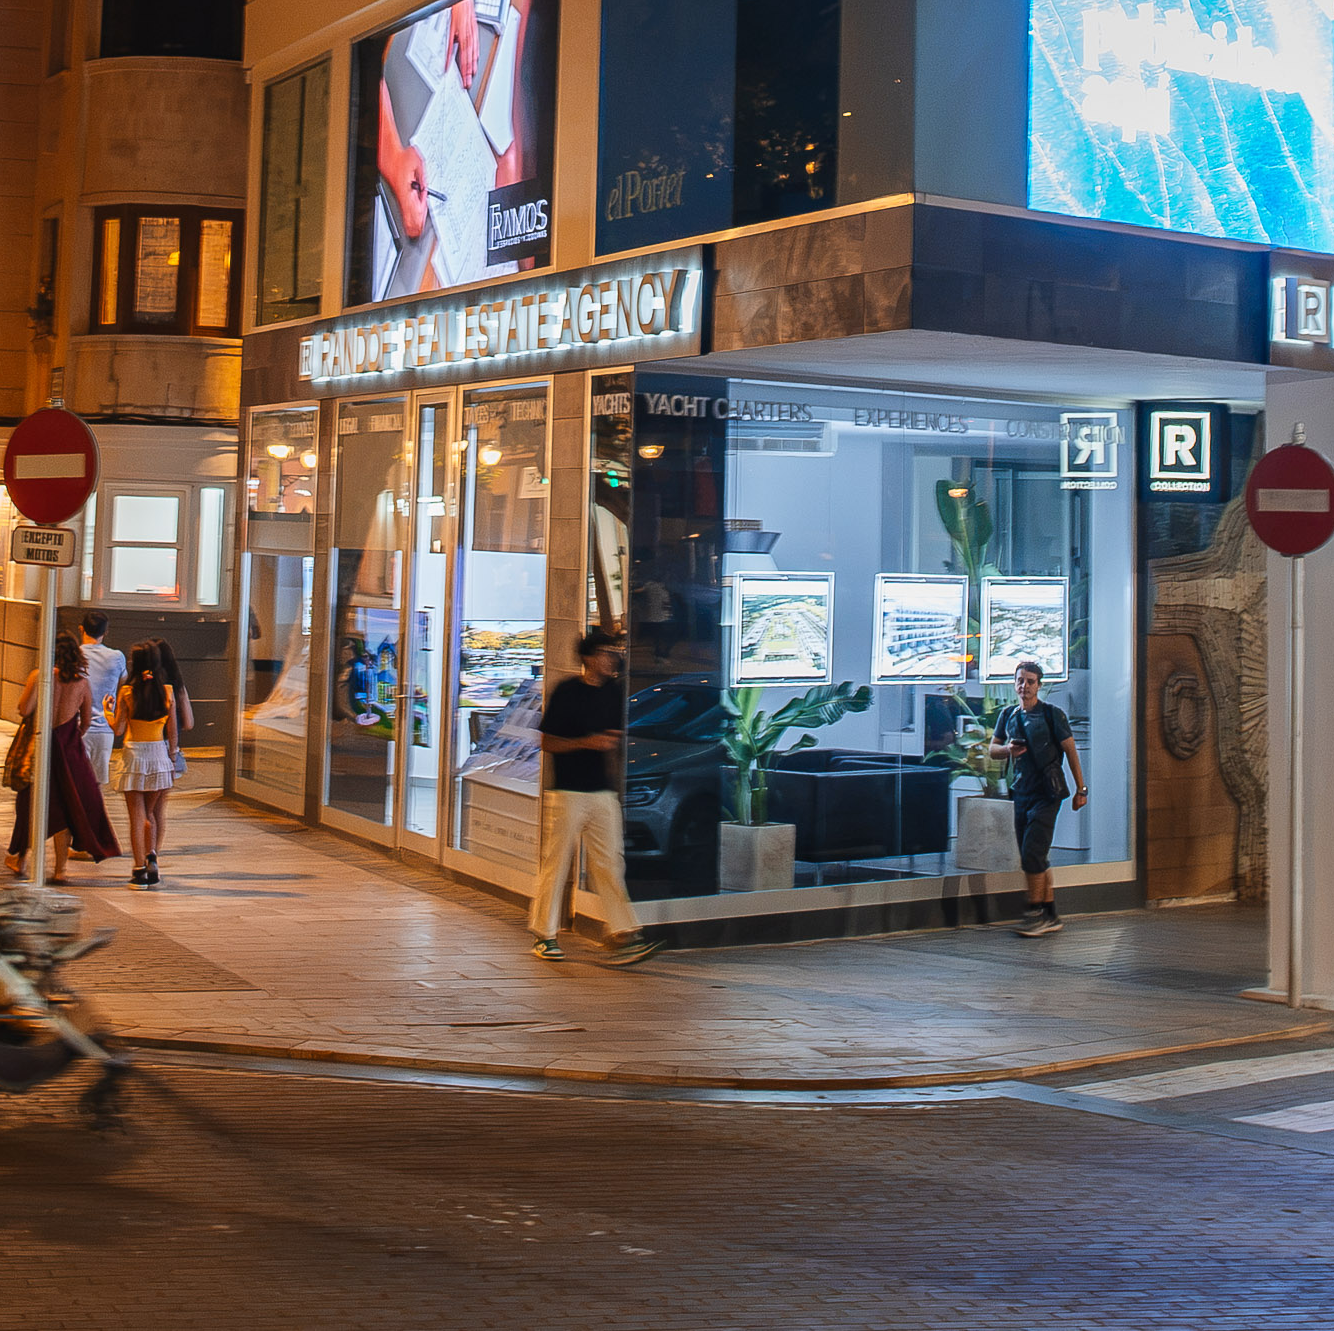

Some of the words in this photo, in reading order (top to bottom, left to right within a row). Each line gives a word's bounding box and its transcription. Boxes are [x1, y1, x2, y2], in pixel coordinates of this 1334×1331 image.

[320, 321, 392, 377] RANDOF
[404, 311, 456, 367] REAL
[465, 293, 550, 358] ESTATE
[560, 269, 688, 344] AGENCY
[593, 392, 631, 416] YACHTS
[644, 393, 710, 418] YACHT
[715, 398, 814, 422] CHARTERS
[854, 408, 968, 434] EXPERIENCES
[1150, 481, 1211, 492] COLLECTION
[21, 530, 65, 547] EXCEPTO
[25, 546, 60, 562] MOTOS
